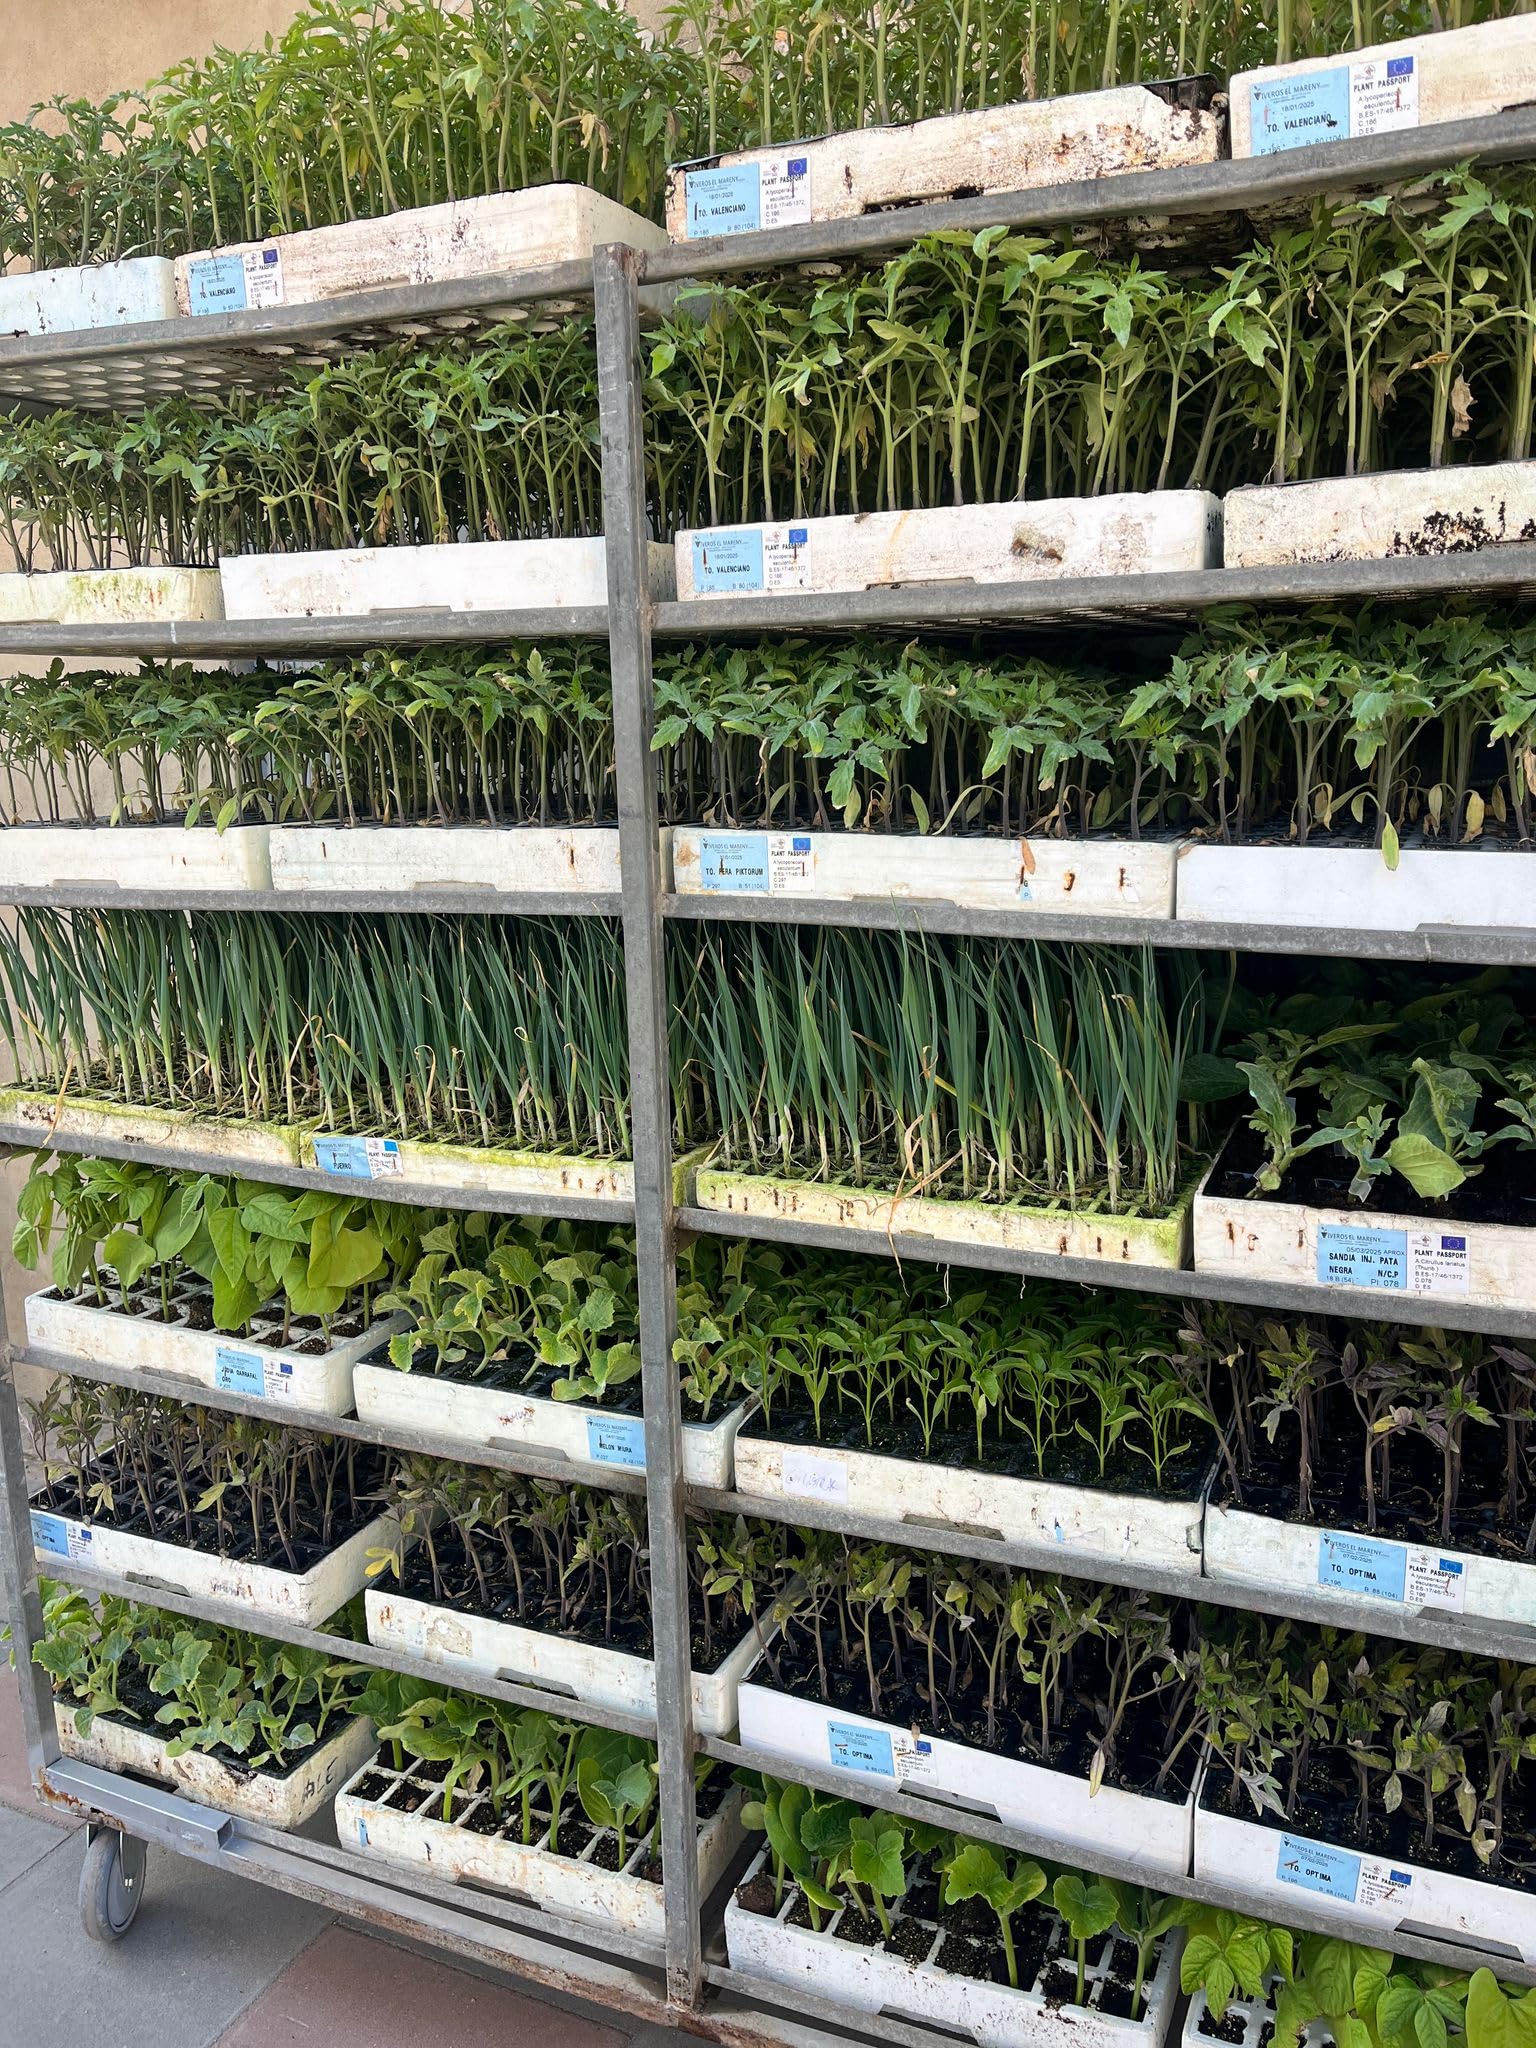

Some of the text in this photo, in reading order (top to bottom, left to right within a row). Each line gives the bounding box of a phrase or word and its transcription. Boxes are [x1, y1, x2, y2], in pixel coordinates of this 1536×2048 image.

[1294, 82, 1320, 93] MARENY
[1354, 82, 1373, 92] PLANT
[1378, 76, 1410, 88] PASSPORT
[1267, 113, 1331, 133] TO. VALENCIANO
[762, 174, 804, 186] PLANT PASSPORT
[711, 204, 746, 215] VALENCIANO
[209, 287, 235, 297] VALENCIANO
[716, 565, 750, 573] VALENCIANO
[1347, 1247, 1381, 1255] 05/03/2025
[1437, 1251, 1466, 1259] PASSPORT
[1329, 1253, 1356, 1262] SANDIA
[1361, 1255, 1375, 1263] INJ.
[1329, 1266, 1399, 1278] NEGRA N/C.P
[618, 1445, 632, 1453] MIURA
[1357, 1547, 1382, 1556] MARENY
[1331, 1564, 1377, 1580] TO. OPTIMA
[1409, 1565, 1459, 1580] PLANT PASSPORT
[1381, 1591, 1398, 1599] (104)
[839, 1748, 873, 1760] TO. OPTIMA
[1315, 1851, 1337, 1862] MARENY
[1290, 1864, 1331, 1882] TO. OPTIMA
[1362, 1872, 1408, 1890] PLANT PASSPORT
[1334, 1890, 1350, 1900] (104)
